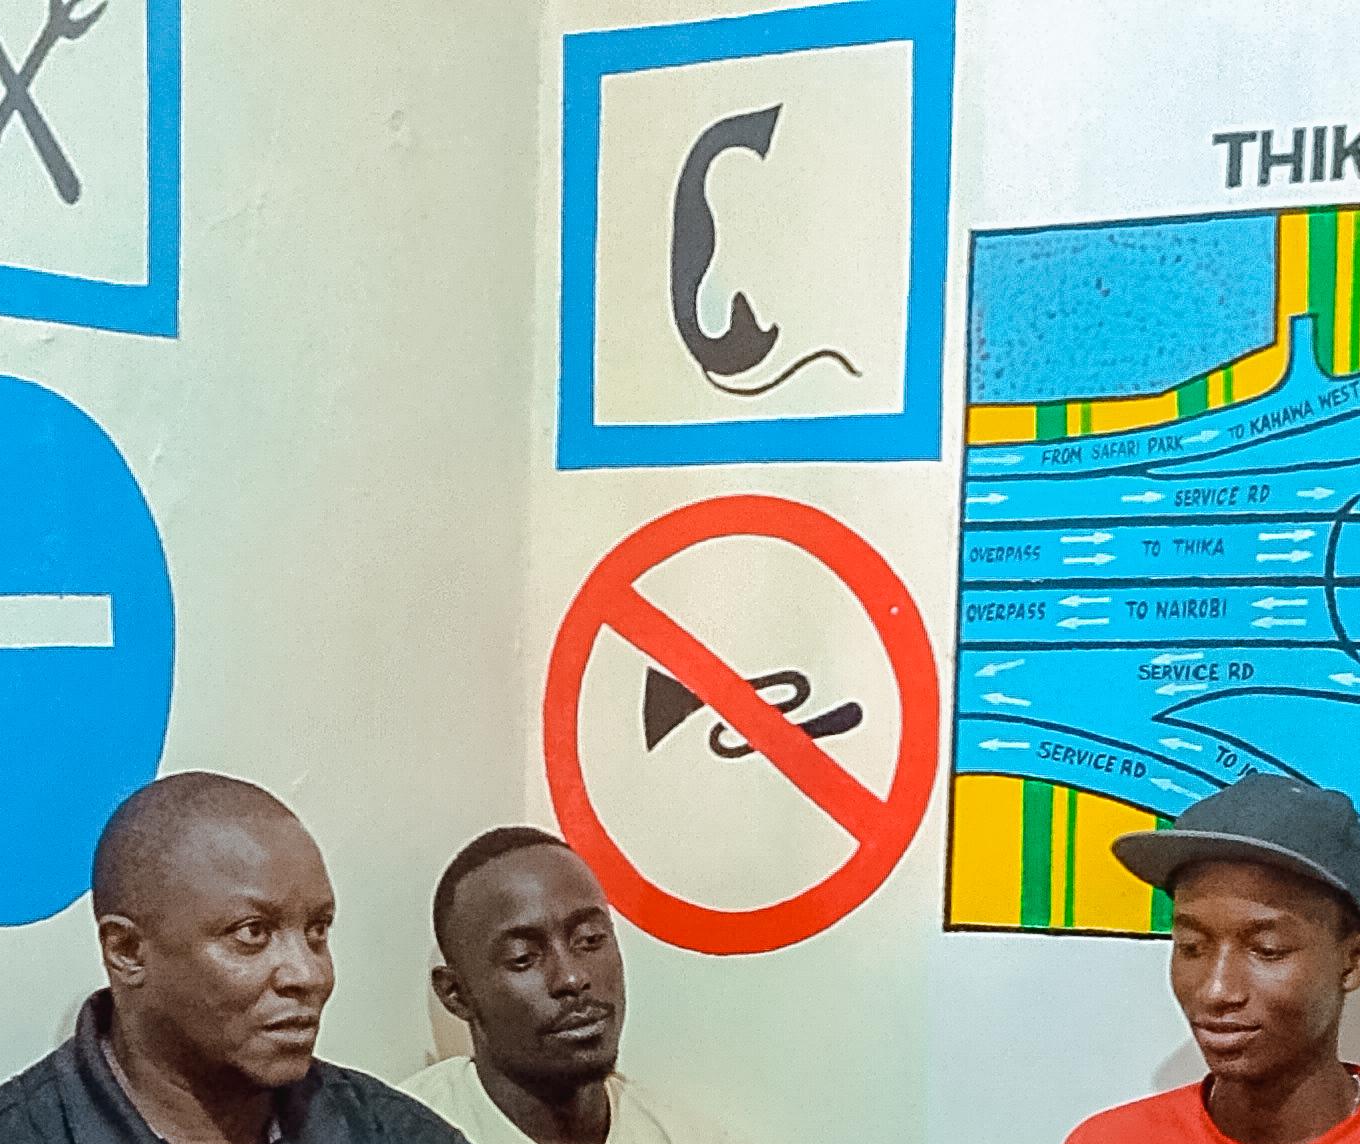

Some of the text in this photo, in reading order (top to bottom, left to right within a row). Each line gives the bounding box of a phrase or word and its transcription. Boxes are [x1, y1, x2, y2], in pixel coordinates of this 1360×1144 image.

[1227, 425, 1245, 440] TO
[1249, 400, 1315, 436] KAHAWA
[1318, 382, 1359, 410] WEST
[1042, 435, 1184, 465] FROM SAFARI PARK
[1174, 485, 1270, 507] SERVICE RD
[969, 545, 1041, 564] OVERPASS
[1141, 538, 1225, 557] TO THIKA
[966, 601, 1046, 623] OVERPASS
[1125, 598, 1227, 620] TO NAIROBI
[1137, 662, 1254, 682] SERVICE RD
[1037, 740, 1147, 780] SERVICE RD
[1216, 745, 1238, 768] TO
